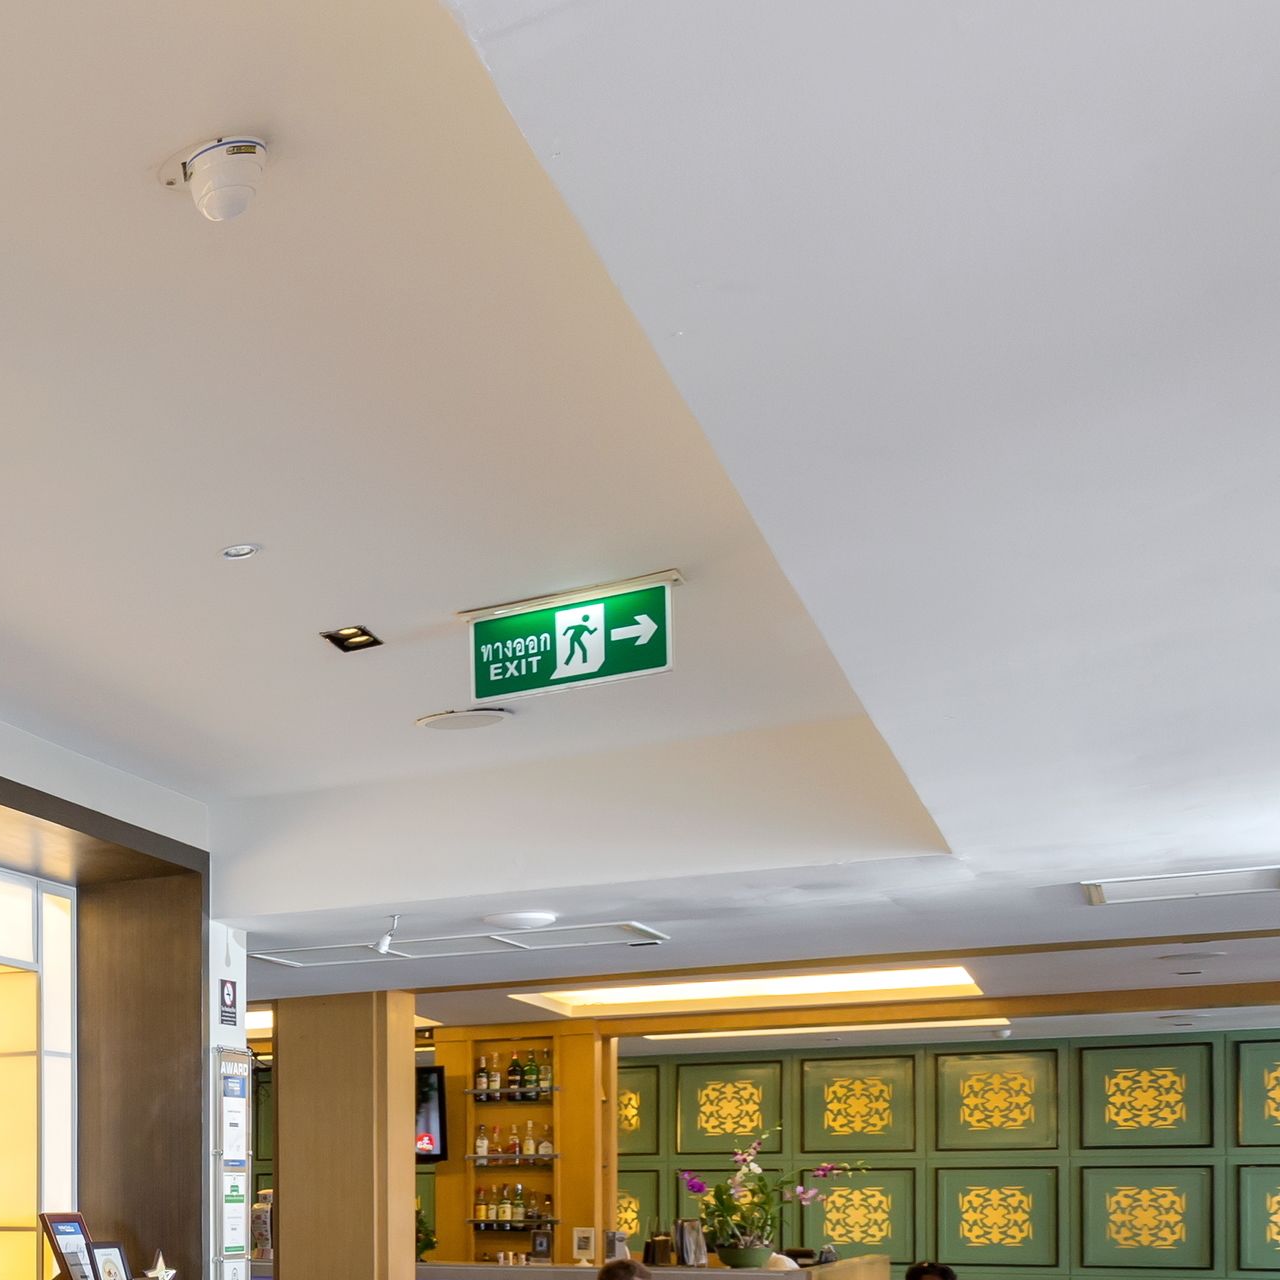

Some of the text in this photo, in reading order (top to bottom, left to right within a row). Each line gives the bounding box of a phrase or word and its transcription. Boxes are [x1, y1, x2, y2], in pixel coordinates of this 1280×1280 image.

[480, 633, 551, 662] ทางออก
[490, 656, 542, 681] EXIT
[221, 1062, 249, 1076] AWARD
